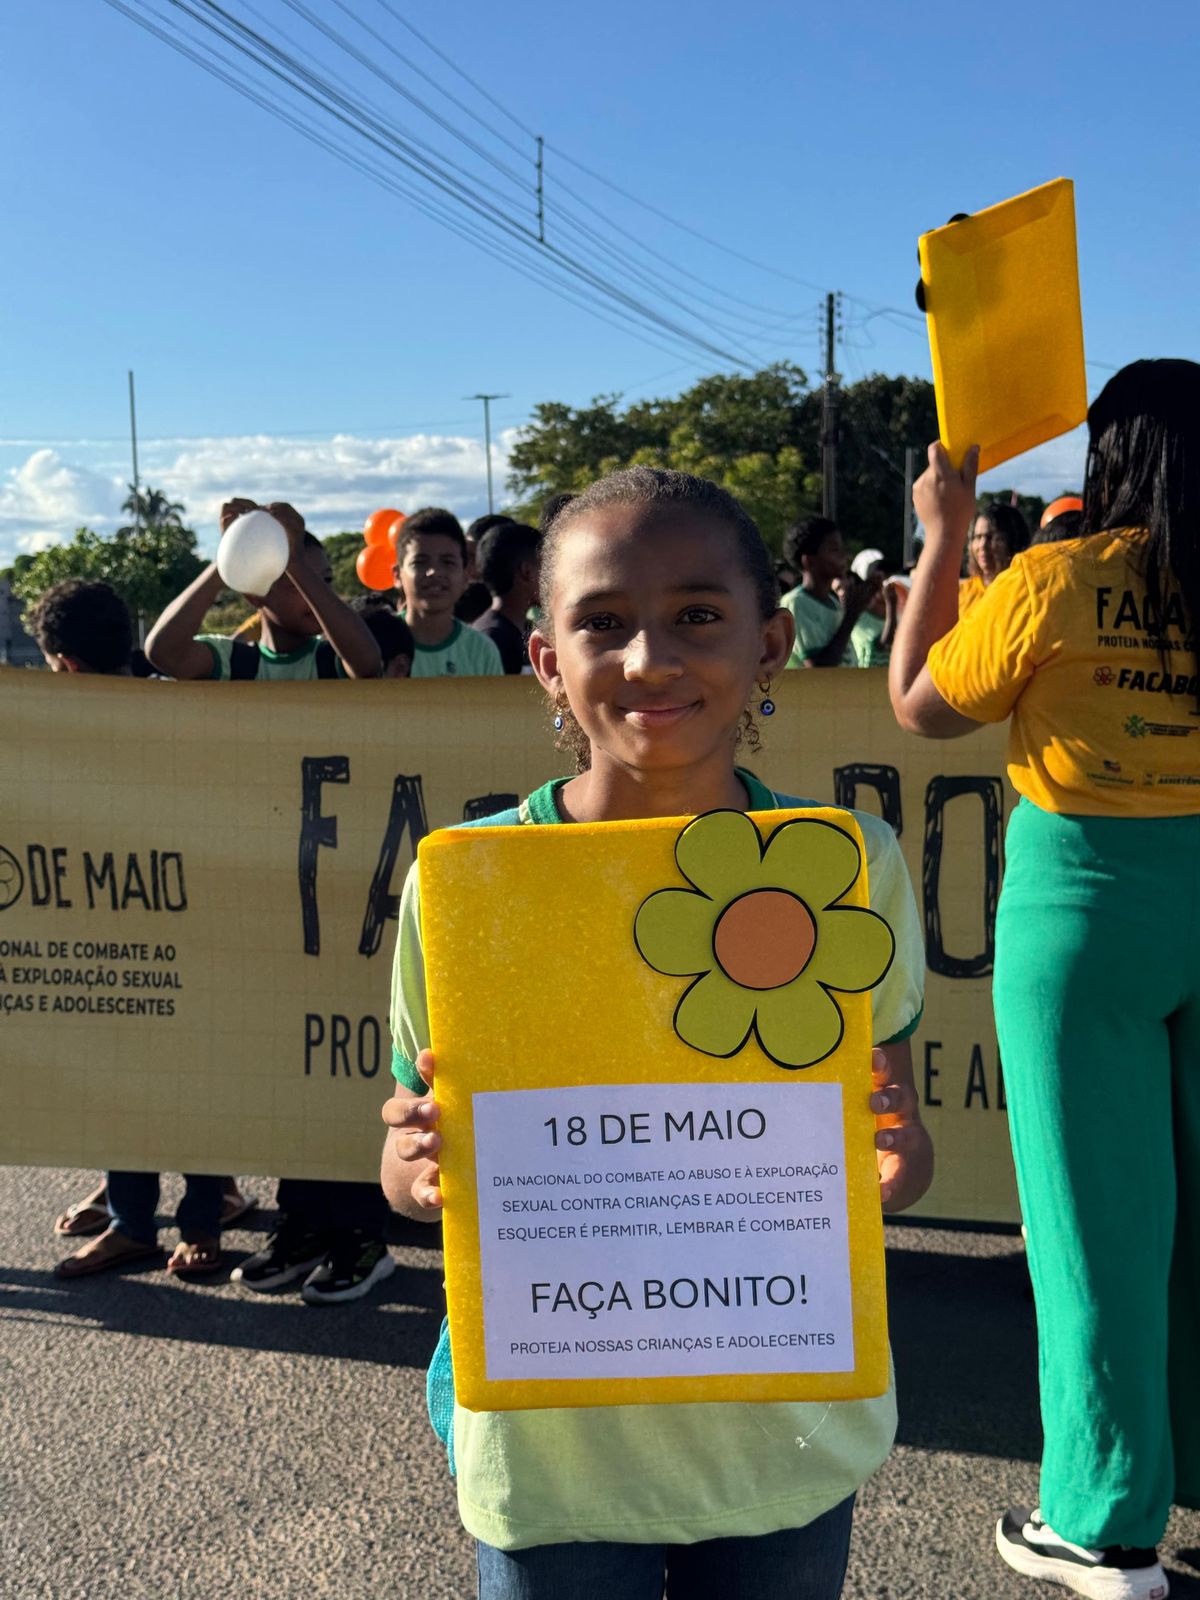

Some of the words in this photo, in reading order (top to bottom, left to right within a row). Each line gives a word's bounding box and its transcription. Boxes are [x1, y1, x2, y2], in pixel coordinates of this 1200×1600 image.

[1098, 635, 1139, 648] PROTEJA
[27, 844, 73, 909] DE
[83, 850, 188, 912] MAIO
[47, 941, 68, 959] DE
[73, 942, 149, 961] COMBATE
[154, 944, 176, 961] AO
[12, 966, 118, 991] EXPLORAÇÃO
[122, 970, 183, 989] SEXUAL
[39, 996, 47, 1011] E
[53, 996, 175, 1015] ADOLESCENTES
[304, 1013, 390, 1078] PRO
[544, 1116, 587, 1146] 18
[600, 1113, 651, 1144] DE
[665, 1109, 766, 1142] MAIO
[493, 1176, 514, 1187] DIA
[517, 1174, 581, 1187] NACIONAL
[584, 1173, 602, 1184] DO
[605, 1171, 665, 1184] COMBATE
[668, 1170, 685, 1181] AO
[688, 1168, 731, 1180] ABUSO
[735, 1168, 742, 1178] E
[745, 1165, 753, 1178] À
[756, 1163, 838, 1178] EXPLORAÇÃO
[502, 1200, 557, 1212] SEXUAL
[561, 1198, 621, 1210] CONTRA
[624, 1195, 700, 1209] CRIANÇAS
[704, 1194, 712, 1205] E
[715, 1190, 823, 1205] ADOLECENTES
[497, 1226, 576, 1241] ESQUECER
[580, 1223, 588, 1238] É
[592, 1223, 662, 1238] PERMITIR,
[666, 1220, 734, 1235] LEMBRAR
[738, 1217, 746, 1232] É
[750, 1217, 831, 1232] COMBATER
[530, 1280, 632, 1319] FAÇA
[643, 1275, 808, 1309] BONITO!
[510, 1340, 571, 1355] PROTEJA
[575, 1338, 633, 1352] NOSSAS
[637, 1336, 712, 1352] CRIANÇAS
[716, 1336, 725, 1348] E
[728, 1333, 835, 1348] ADOLECENTES
